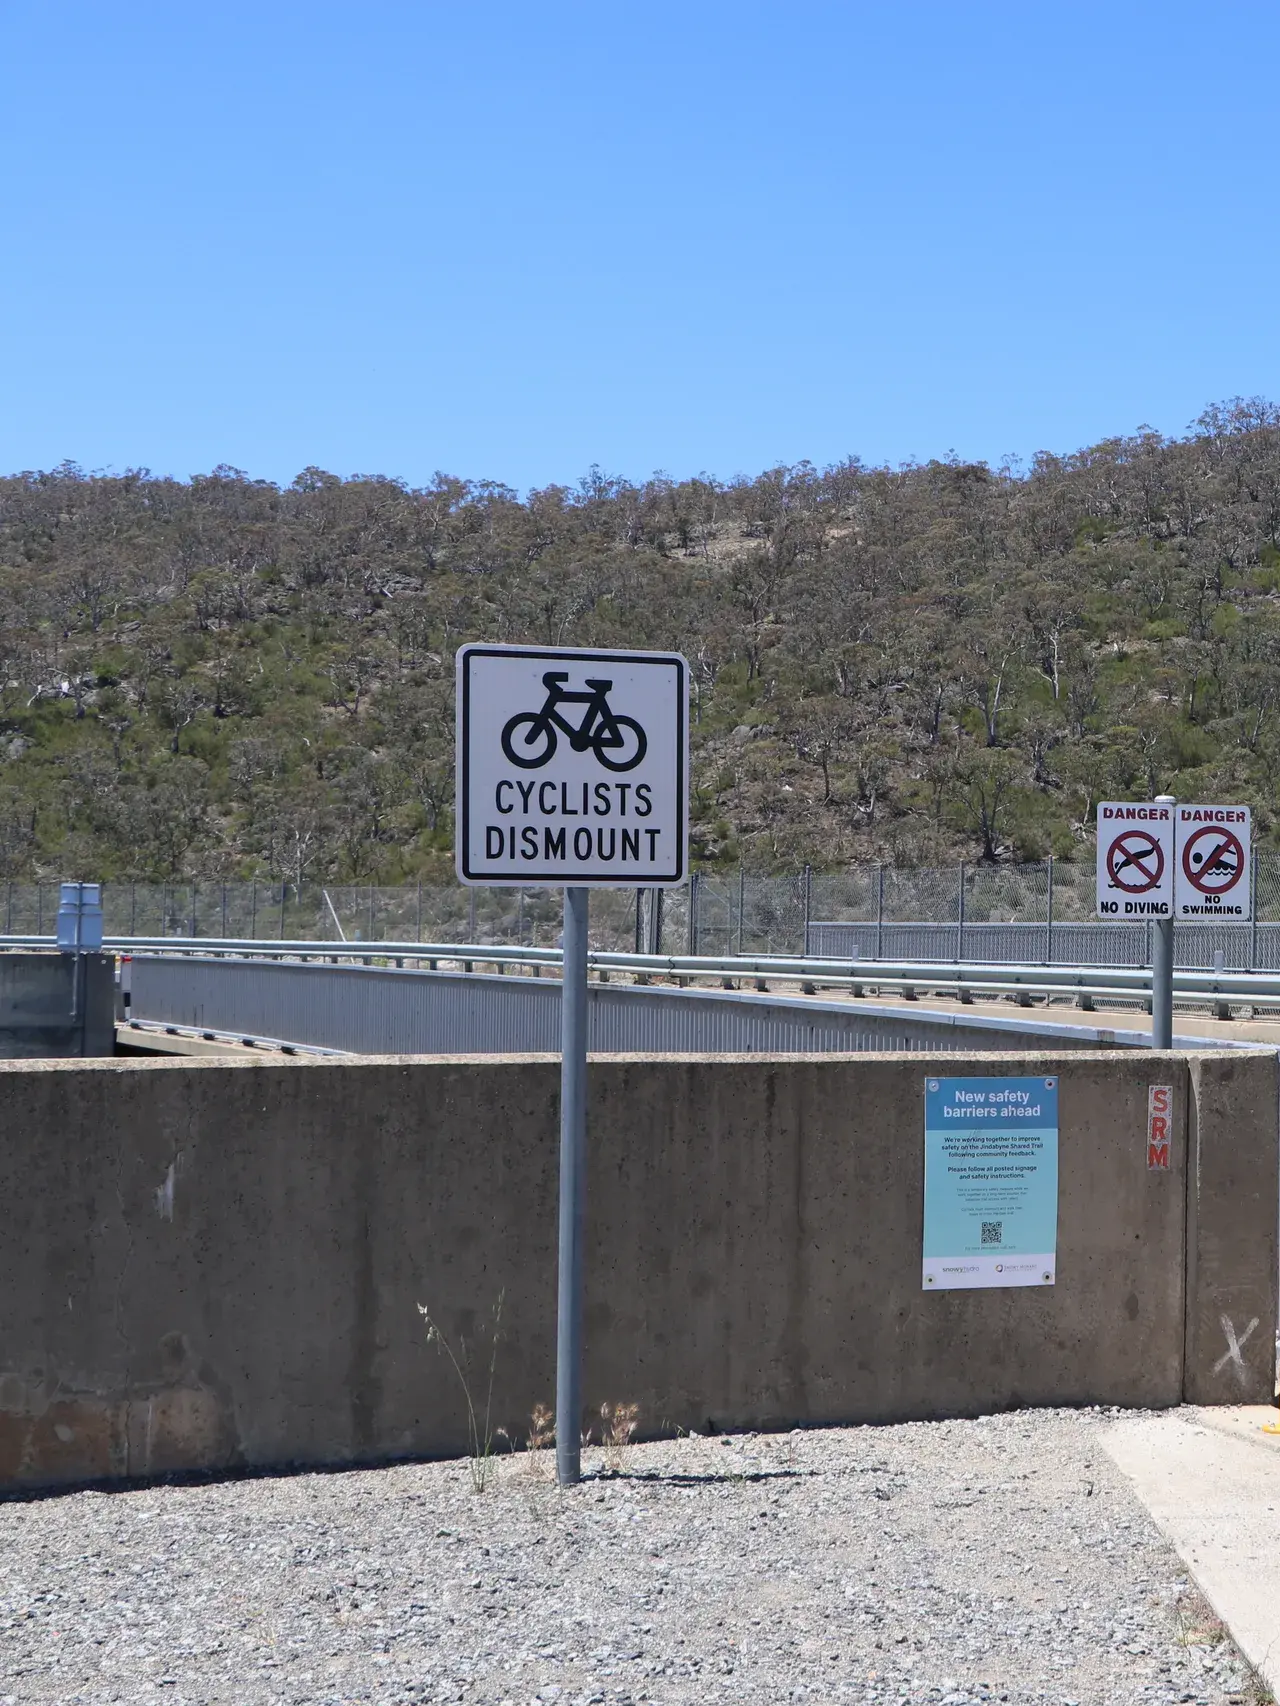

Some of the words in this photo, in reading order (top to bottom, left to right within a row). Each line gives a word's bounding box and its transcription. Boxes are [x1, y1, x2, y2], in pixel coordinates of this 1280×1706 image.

[495, 780, 652, 817] CYCLISTS
[1103, 807, 1169, 821] DANGER
[1181, 810, 1246, 823] DANGER
[486, 826, 661, 861] DISMOUNT
[1204, 895, 1221, 904] NO
[1100, 901, 1119, 914] NO
[1124, 902, 1169, 914] DIVING
[1182, 905, 1242, 915] SWIMMING
[955, 1090, 985, 1103] New
[988, 1089, 1030, 1105] safety
[943, 1105, 997, 1118] barriers
[1000, 1104, 1041, 1117] ahead
[980, 1143, 1009, 1151] Jindabyne
